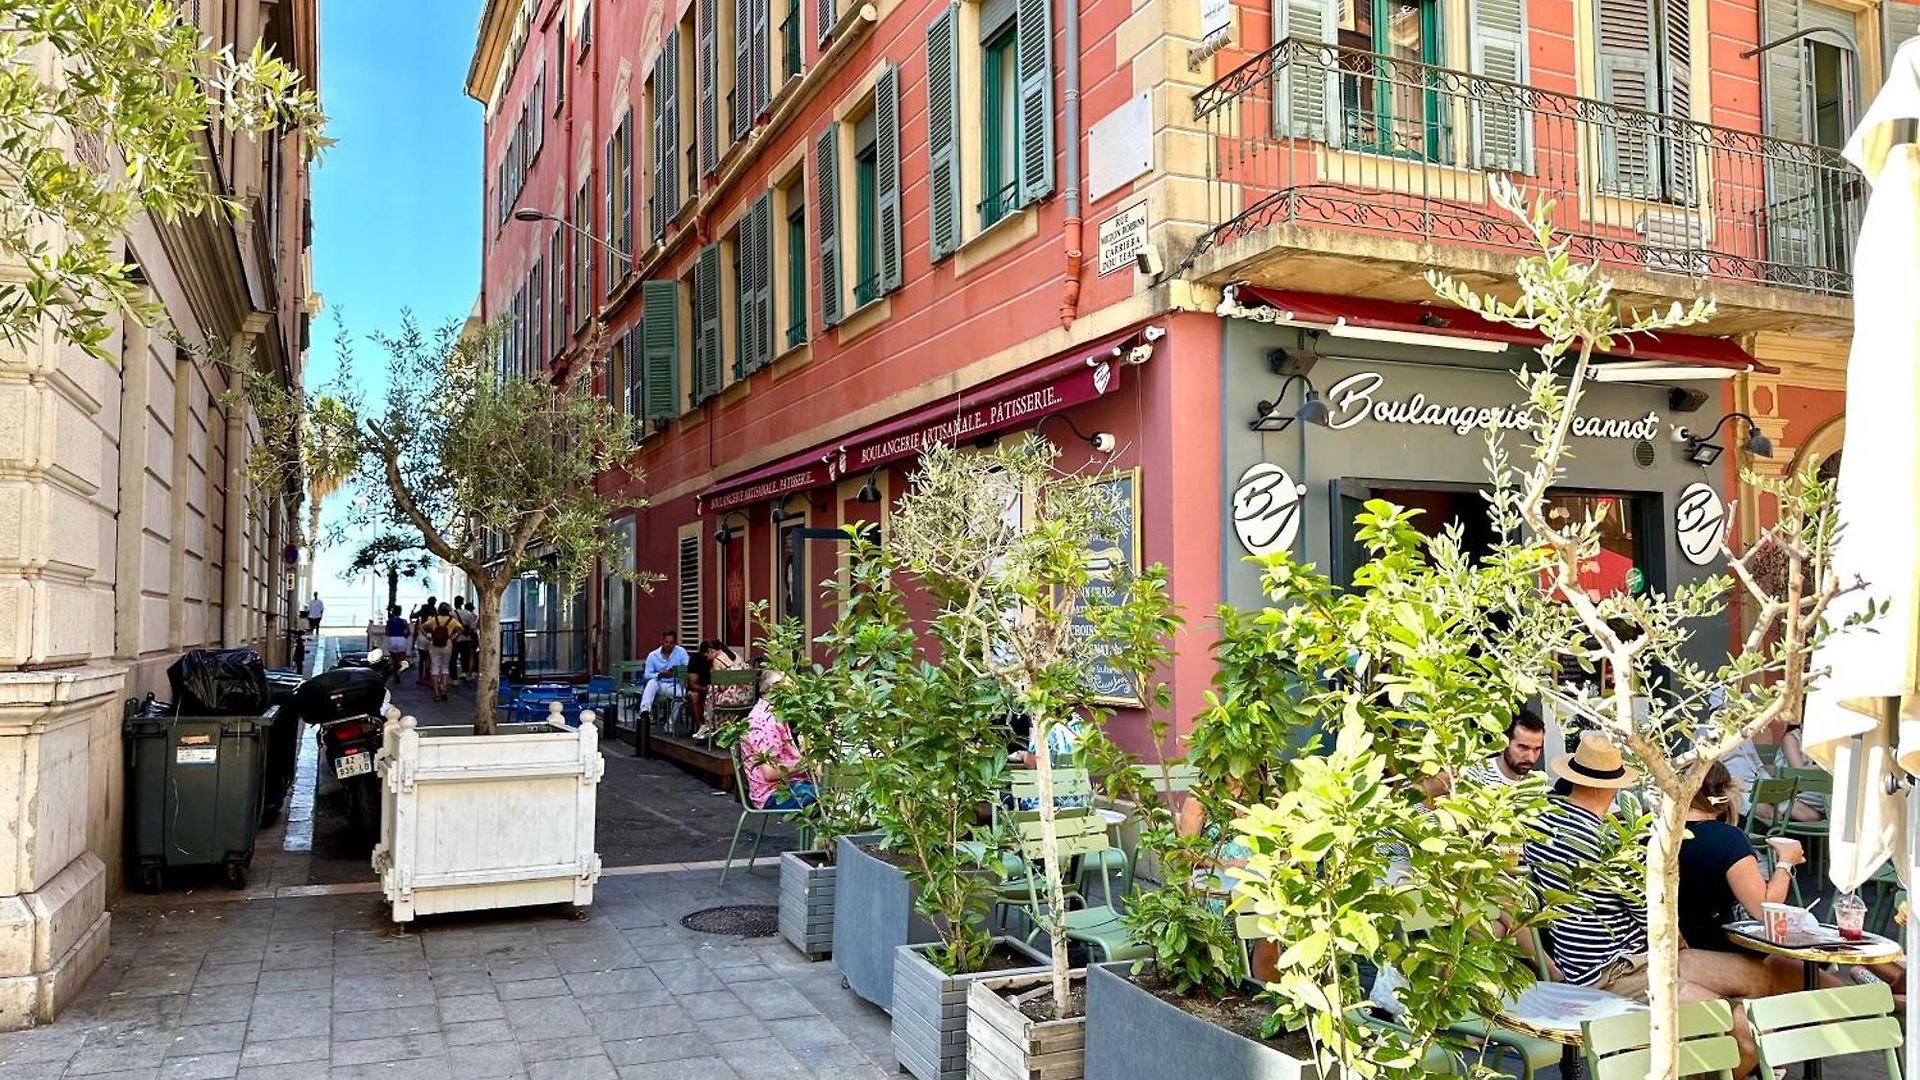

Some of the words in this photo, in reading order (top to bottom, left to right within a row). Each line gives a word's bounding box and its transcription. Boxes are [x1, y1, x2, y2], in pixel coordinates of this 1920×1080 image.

[1115, 213, 1129, 228] RUE
[1534, 404, 1660, 443] eannot
[861, 432, 920, 463] BOULANGERIE
